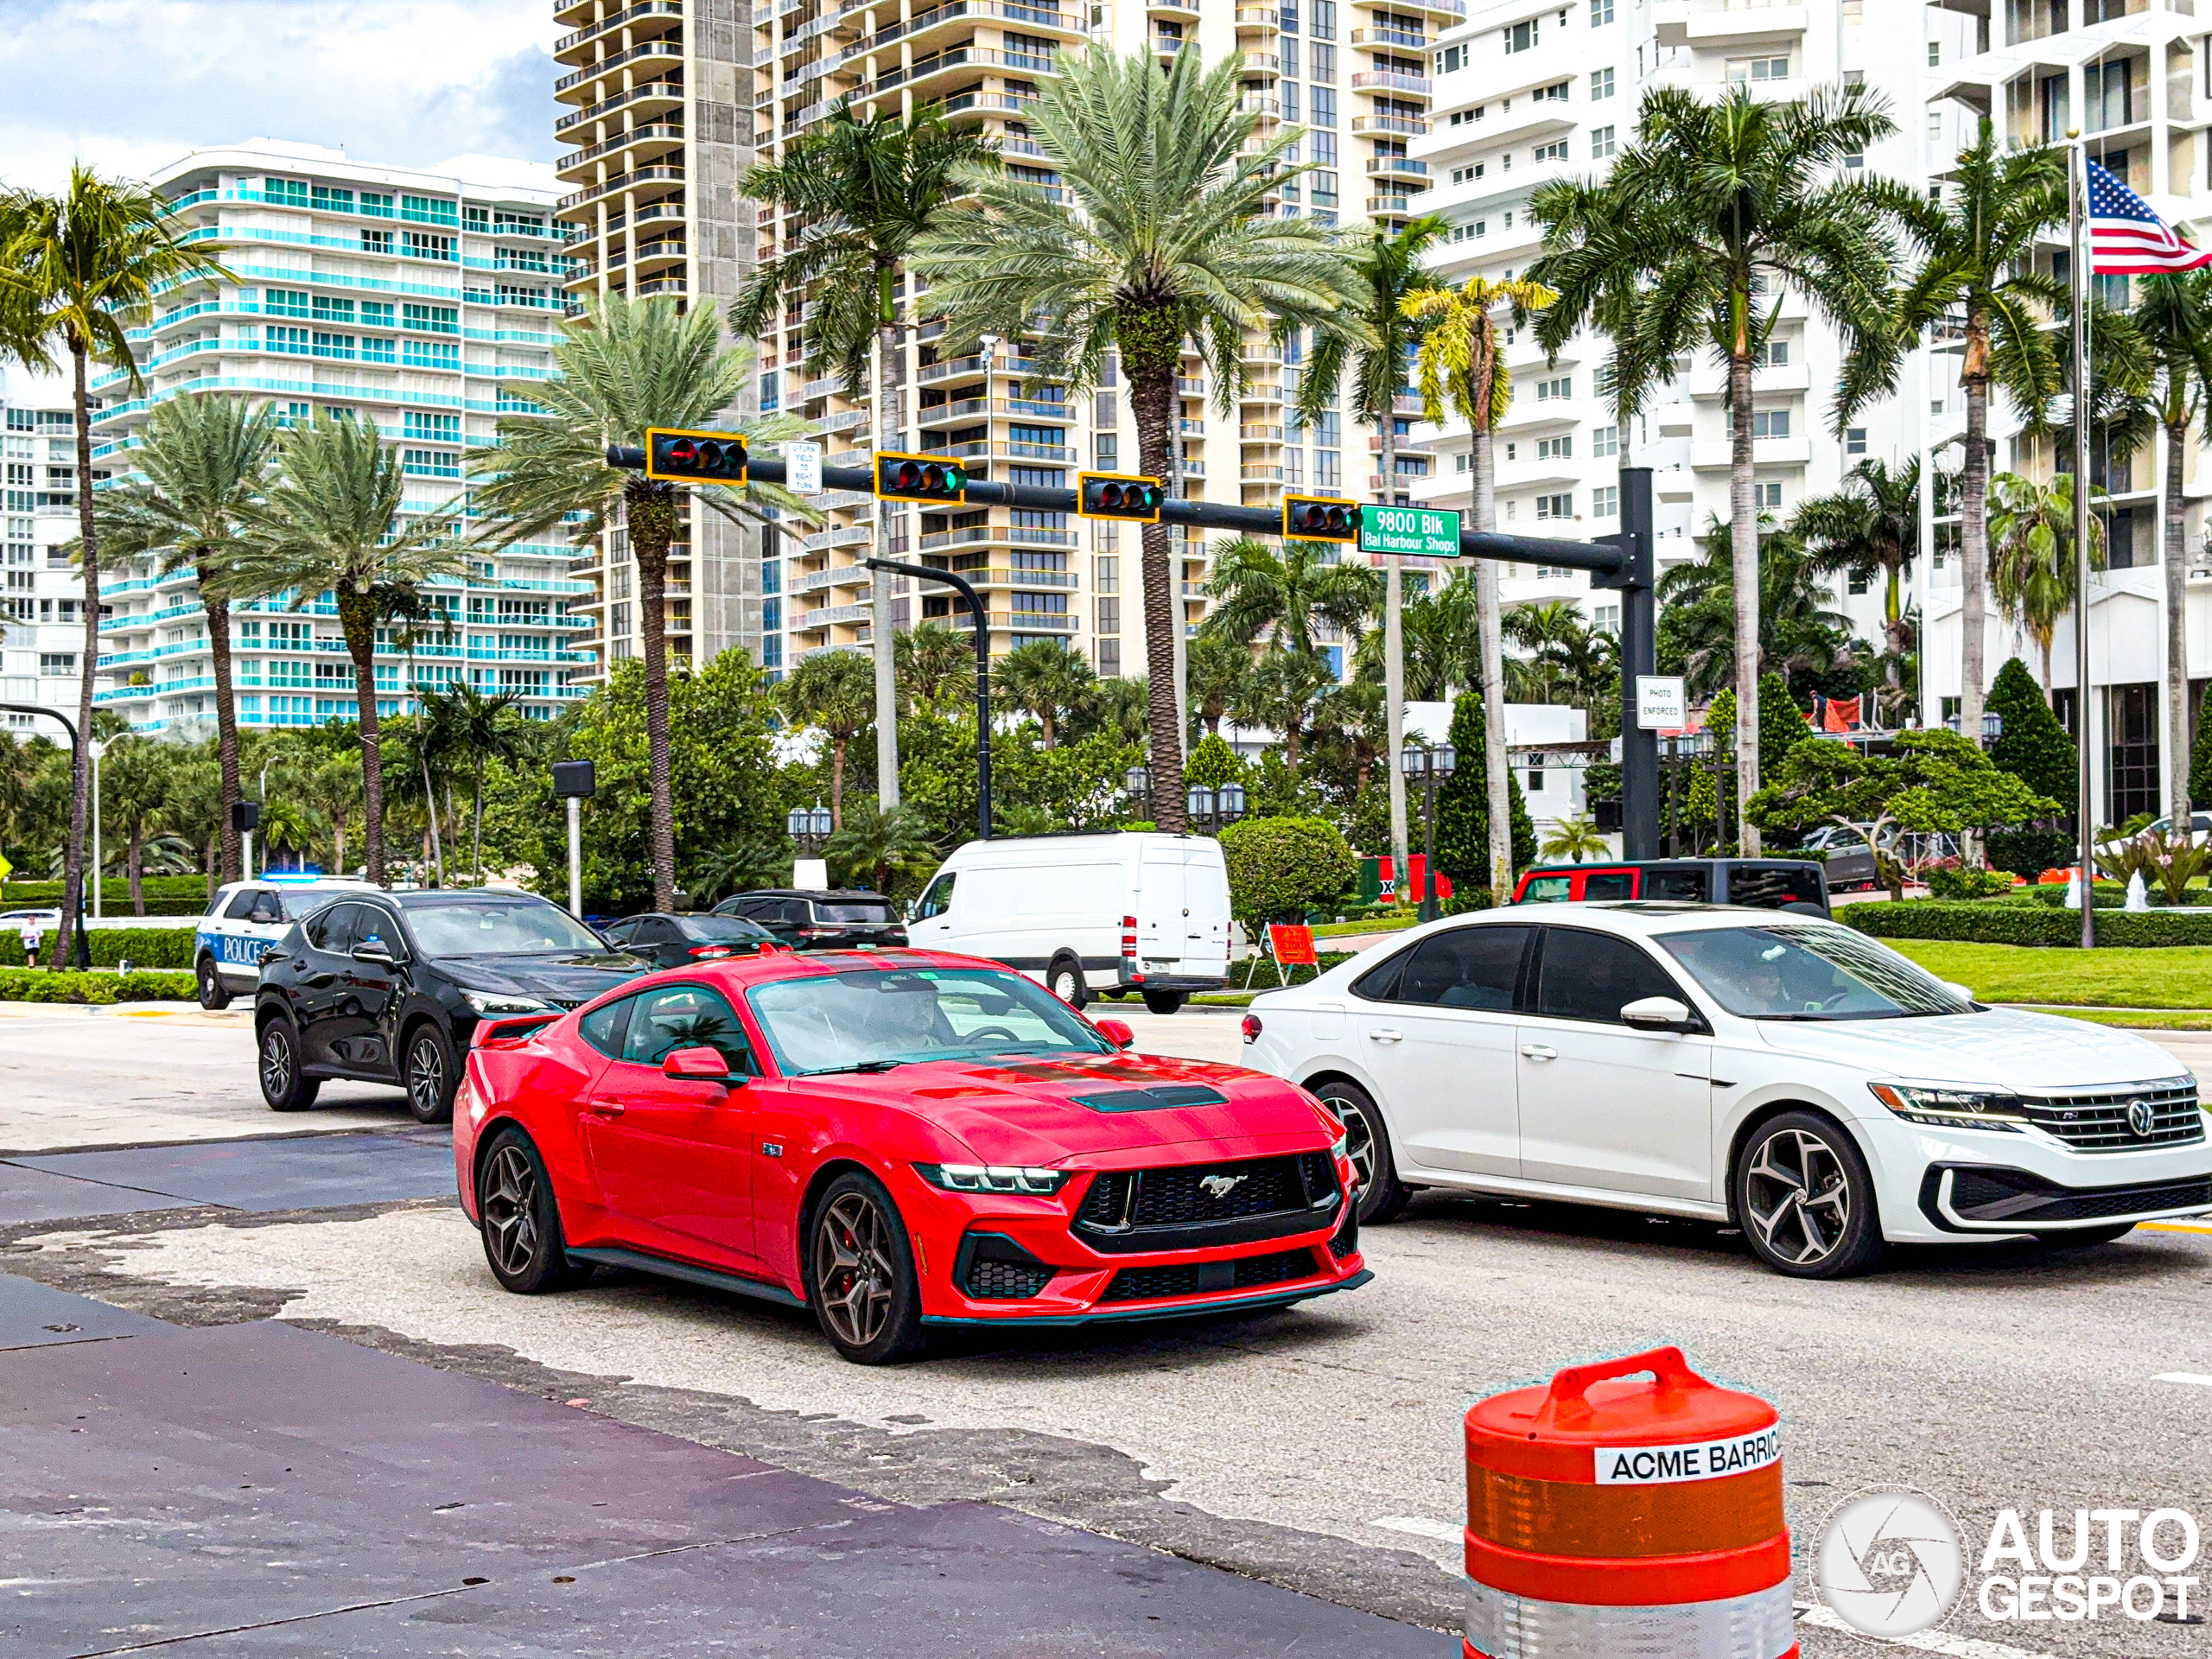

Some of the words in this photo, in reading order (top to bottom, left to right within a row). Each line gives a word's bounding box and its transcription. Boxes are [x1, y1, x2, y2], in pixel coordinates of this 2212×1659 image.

[1376, 511, 1415, 533] 9800
[1421, 514, 1444, 535] Blk
[1365, 532, 1381, 547] Bal
[1383, 533, 1422, 550] Harbour
[1426, 537, 1456, 555] Shops
[1643, 707, 1678, 715] ENFORCED
[225, 938, 260, 963] POLICE
[1611, 1448, 1700, 1479] ACME
